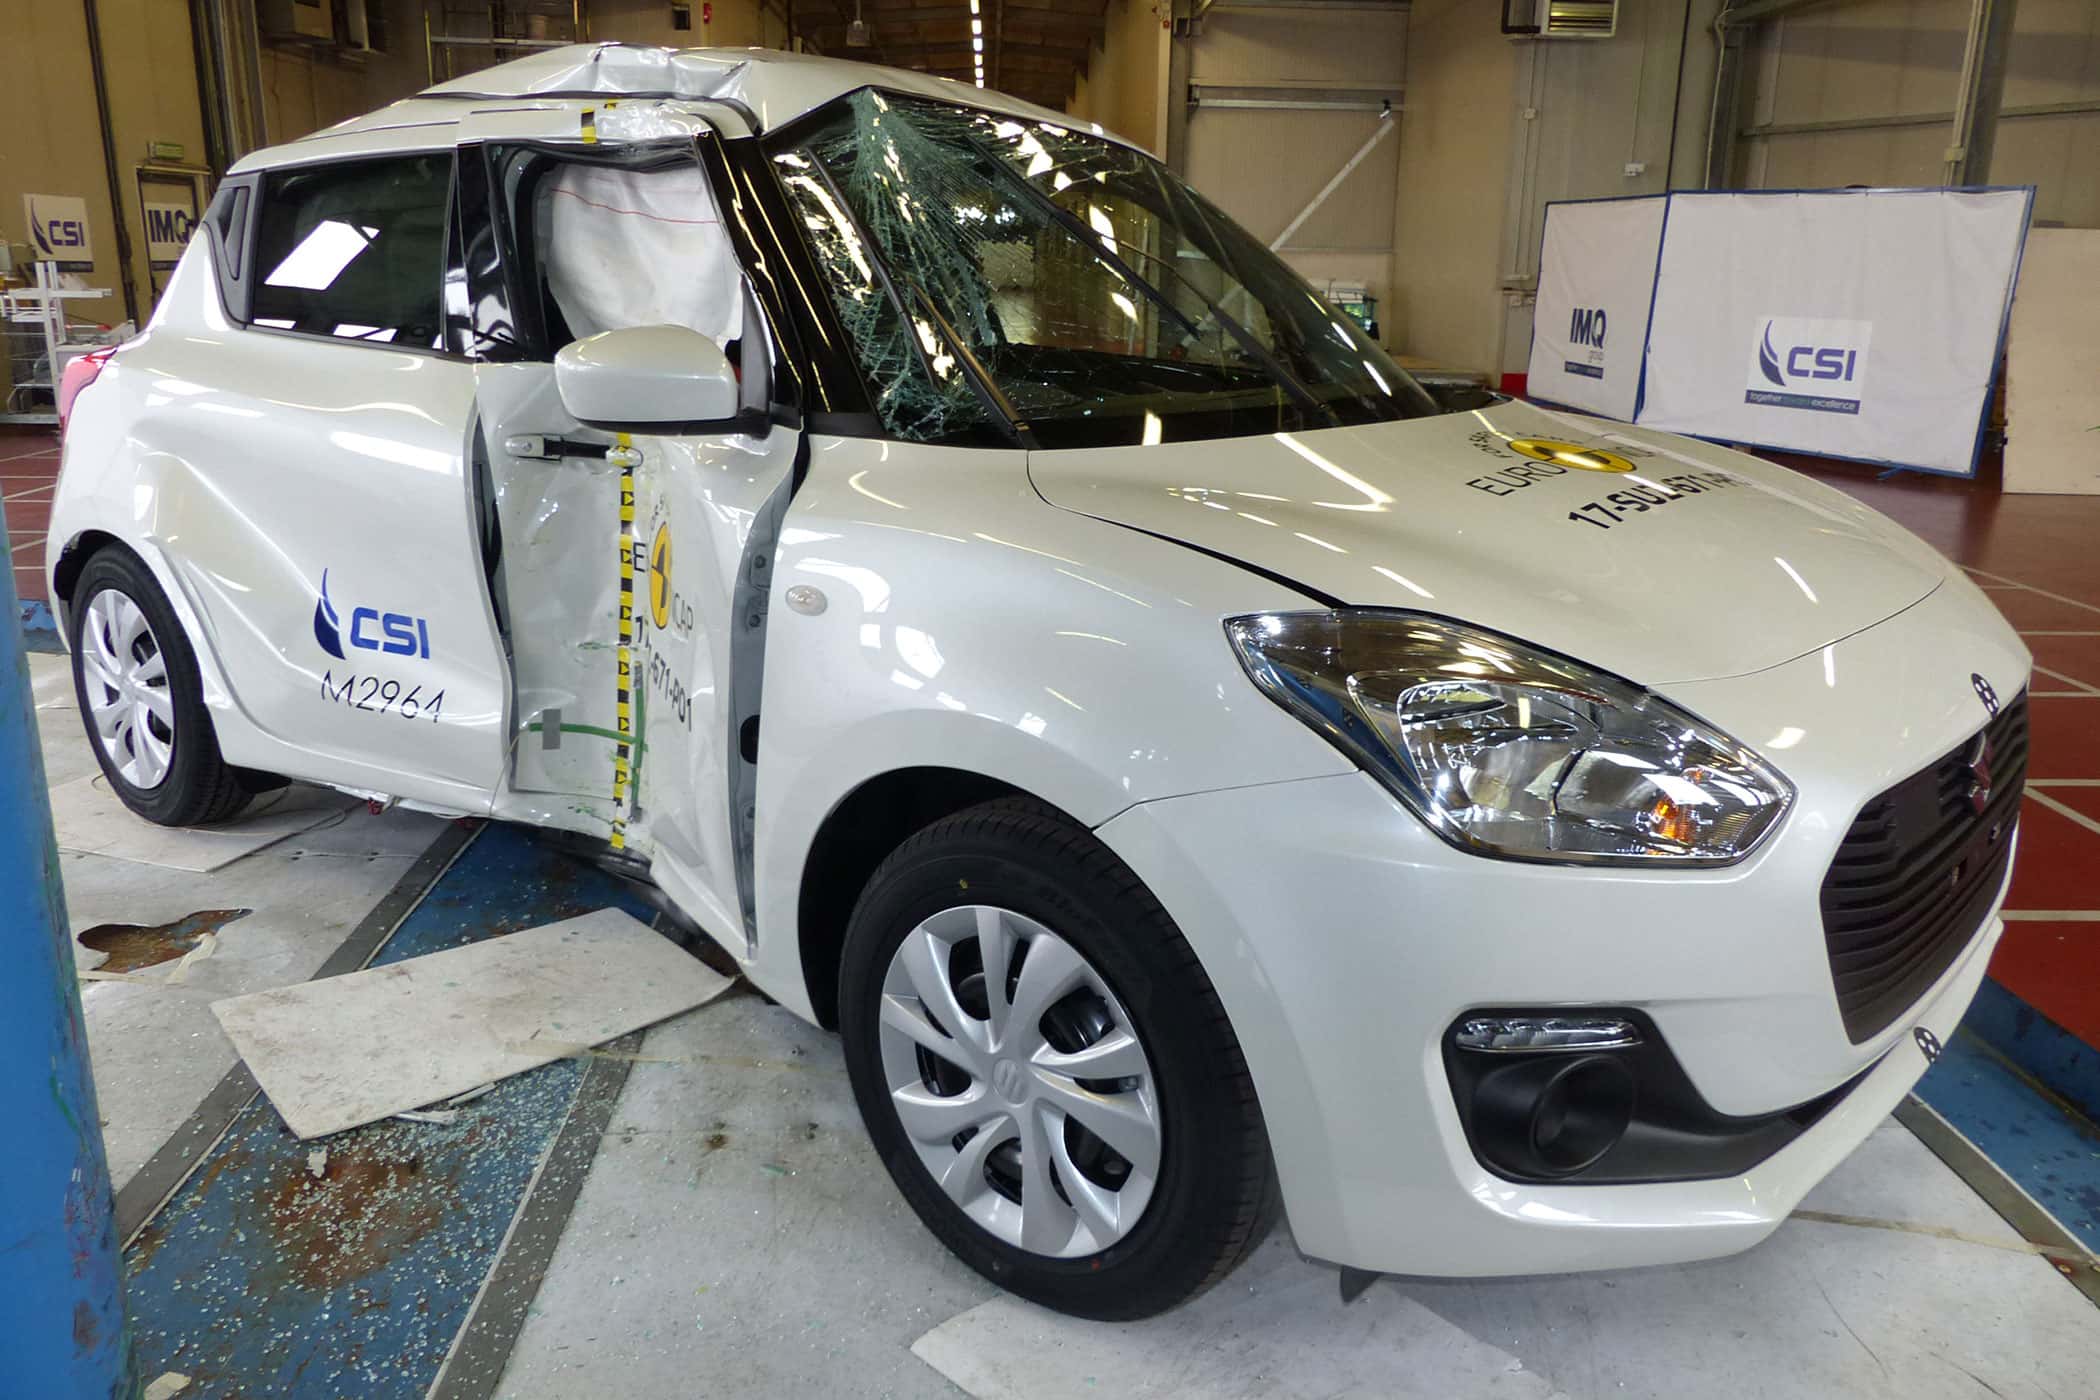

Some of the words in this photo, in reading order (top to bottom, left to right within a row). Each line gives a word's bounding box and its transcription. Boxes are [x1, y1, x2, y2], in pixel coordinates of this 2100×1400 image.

[48, 220, 85, 247] CSI
[1570, 309, 1606, 349] IMQ
[1787, 346, 1856, 382] CSI
[1465, 461, 1568, 497] EURO
[350, 606, 430, 660] CSI
